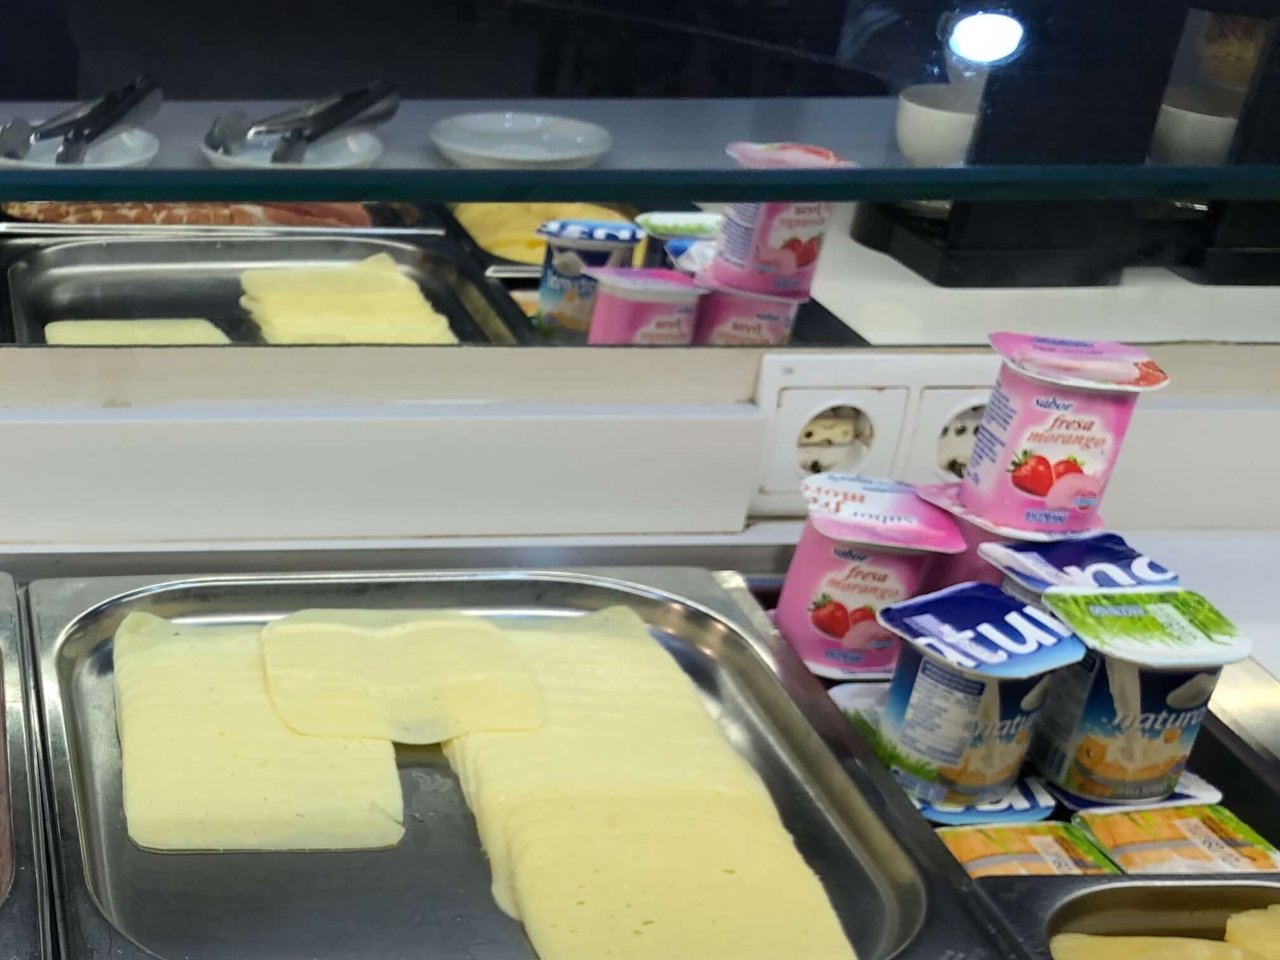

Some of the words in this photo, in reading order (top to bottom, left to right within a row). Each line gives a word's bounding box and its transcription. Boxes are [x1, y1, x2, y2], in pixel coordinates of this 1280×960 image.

[1035, 397, 1073, 411] sabor
[1044, 413, 1095, 432] fresa
[1027, 431, 1107, 451] morango
[833, 547, 868, 561] sabor
[844, 564, 888, 583] fresa
